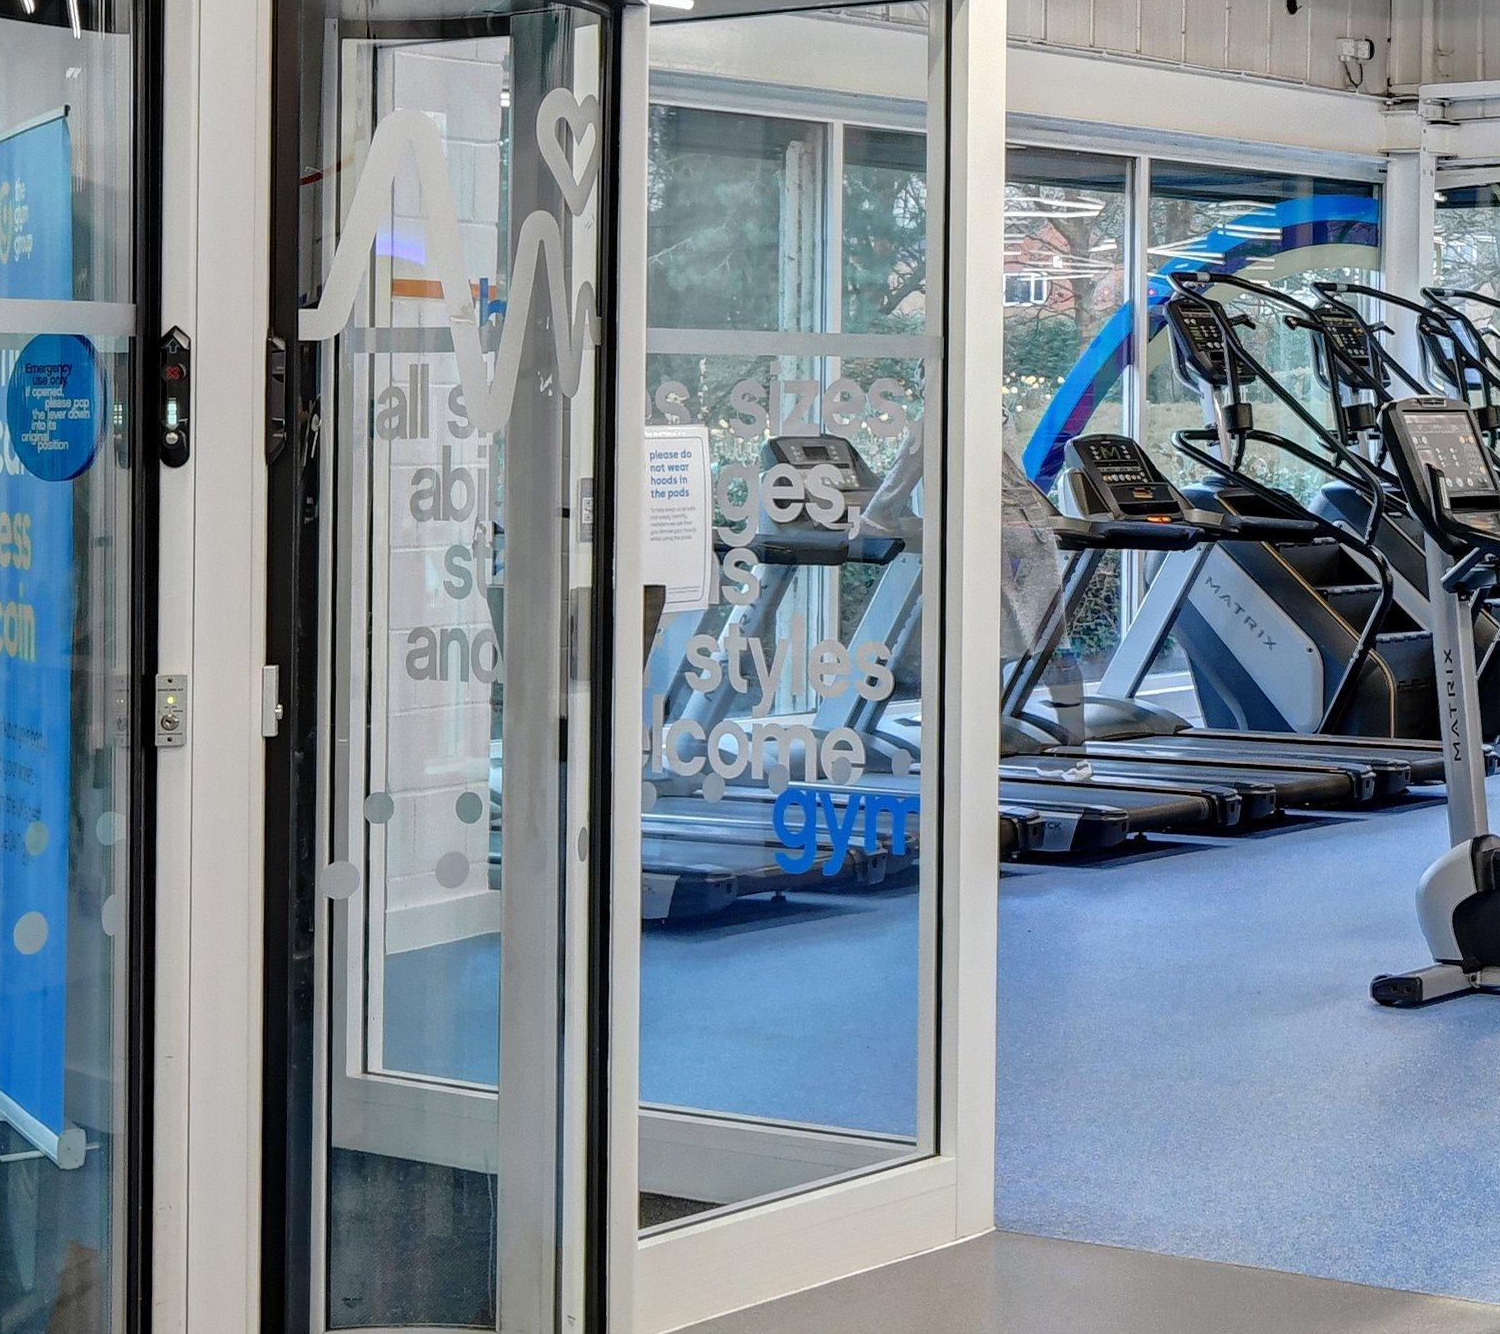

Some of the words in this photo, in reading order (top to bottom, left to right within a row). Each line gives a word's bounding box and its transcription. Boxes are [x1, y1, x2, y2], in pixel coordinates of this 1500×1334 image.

[25, 363, 72, 377] Emergency
[32, 377, 48, 385] use
[45, 398, 71, 410] please
[73, 398, 90, 411] pop
[376, 364, 430, 440] all
[728, 360, 925, 456] sizes,
[32, 409, 45, 419] the
[47, 409, 66, 420] lever
[68, 409, 90, 419] down
[21, 431, 50, 445] original
[38, 441, 69, 453] position
[649, 450, 678, 461] please
[681, 449, 692, 459] do
[650, 463, 665, 473] not
[668, 463, 689, 473] wear
[650, 476, 678, 485] hoods
[680, 475, 688, 484] in
[650, 489, 666, 498] the
[668, 488, 690, 500] pods
[713, 463, 861, 547] ges,
[1204, 575, 1277, 651] MATRIX
[686, 613, 897, 718] styles
[1443, 649, 1462, 762] MATRIX
[643, 693, 867, 786] lcome
[772, 788, 921, 877] gym
